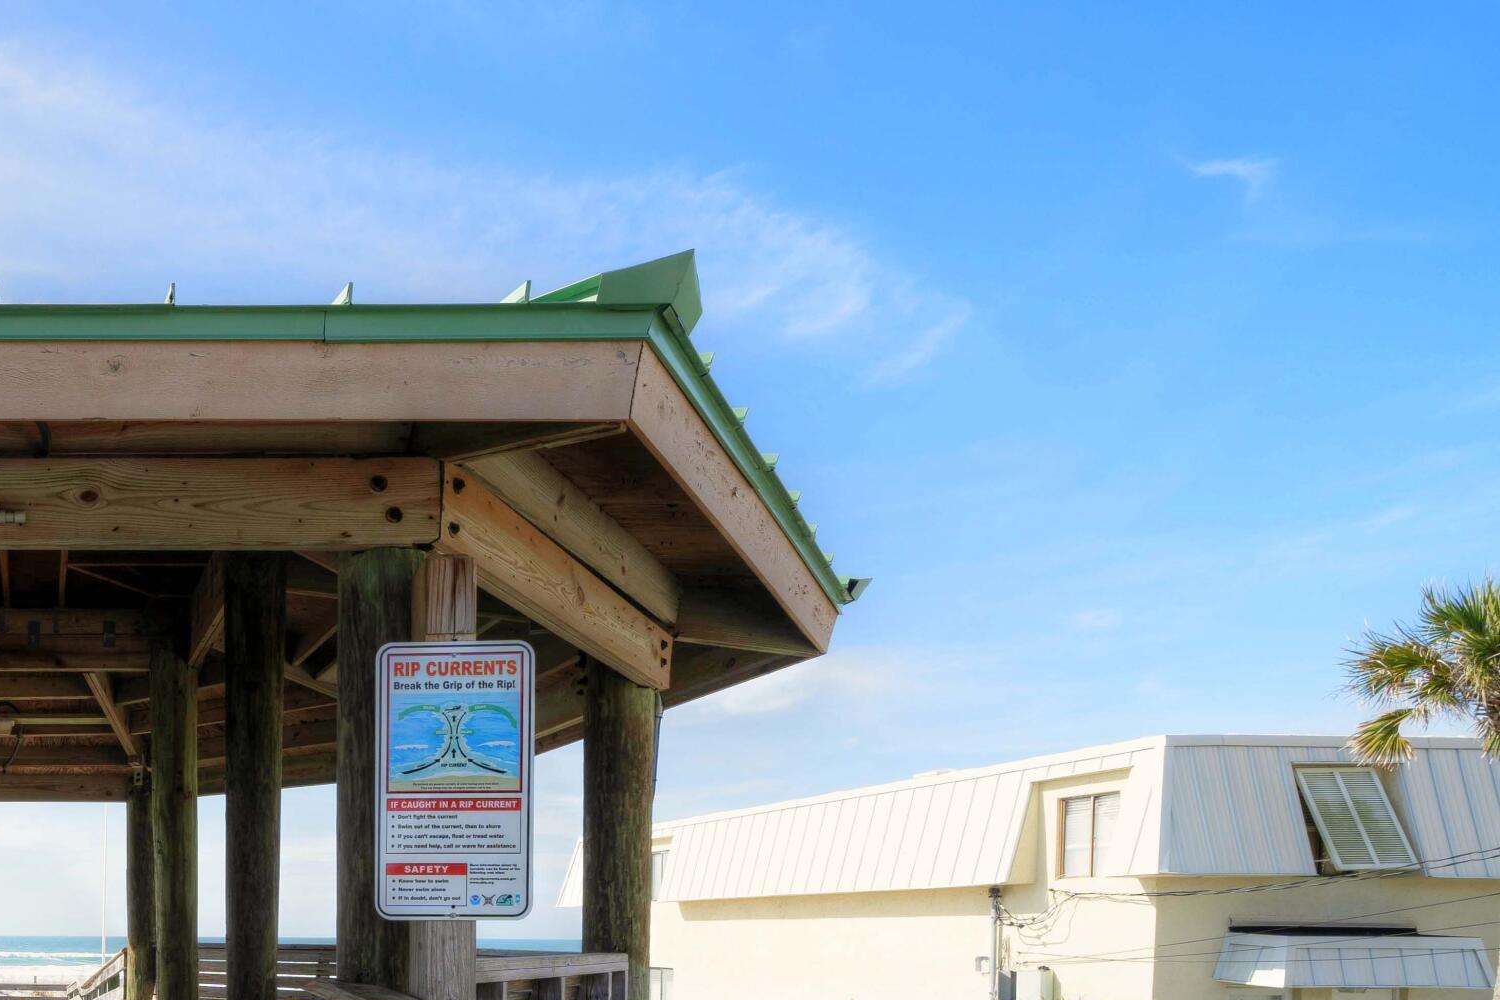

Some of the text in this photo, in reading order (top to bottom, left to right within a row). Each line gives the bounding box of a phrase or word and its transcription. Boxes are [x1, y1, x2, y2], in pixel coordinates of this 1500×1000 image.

[394, 660, 517, 676] RIP CURRENTS
[394, 680, 515, 691] Break the Grip of the Rip!
